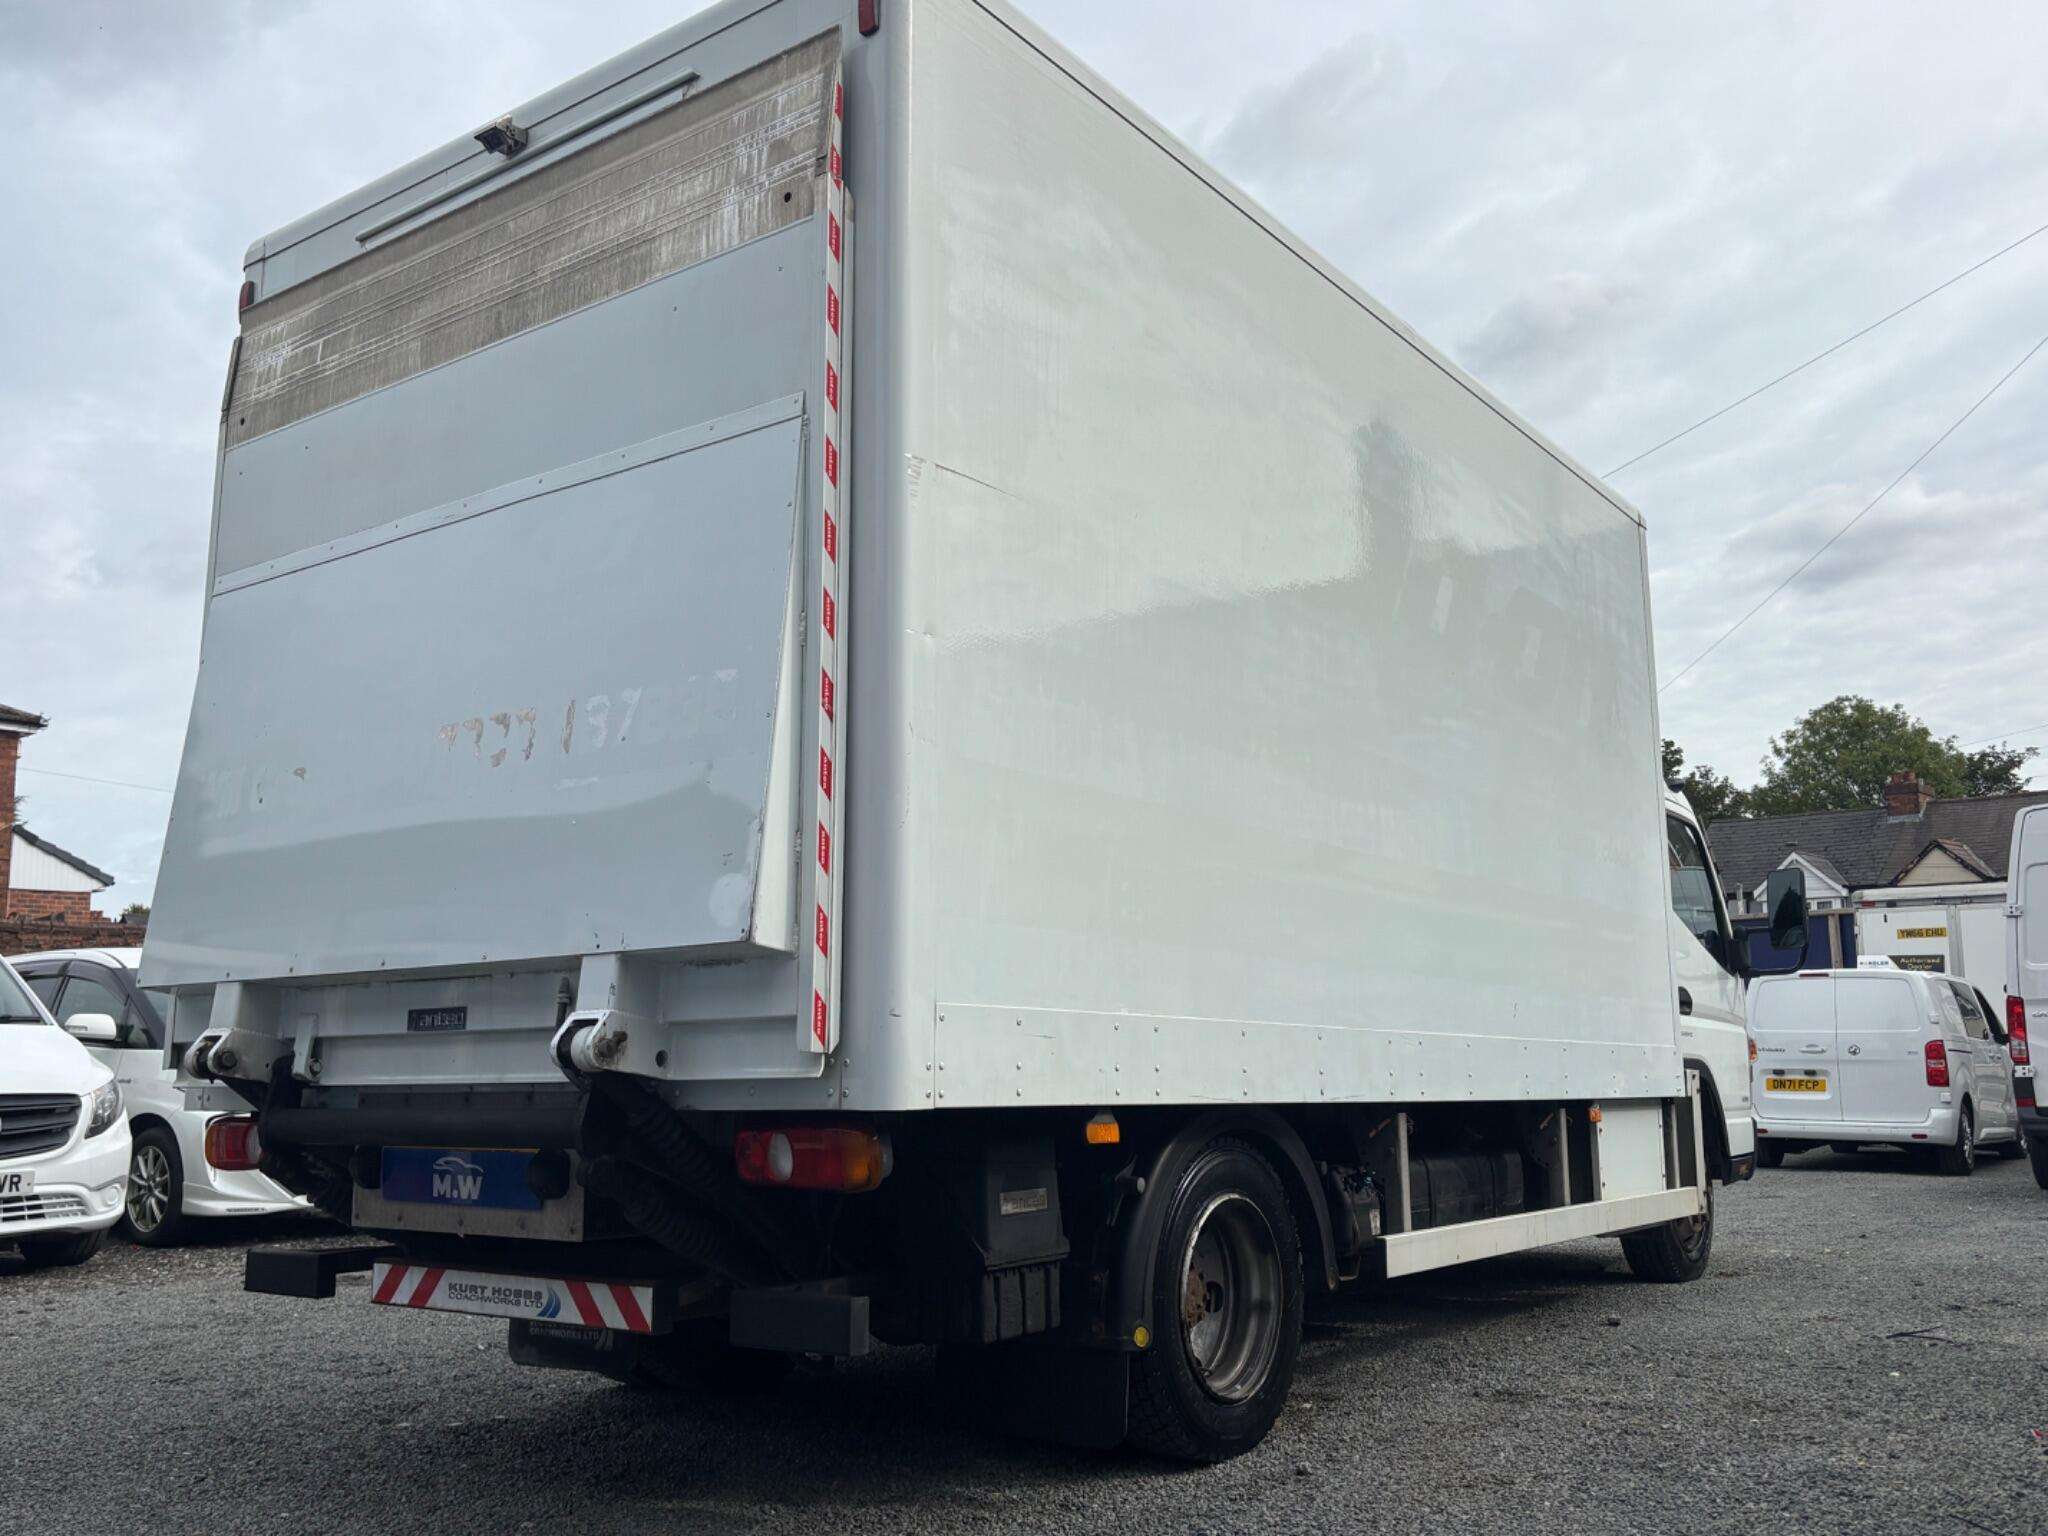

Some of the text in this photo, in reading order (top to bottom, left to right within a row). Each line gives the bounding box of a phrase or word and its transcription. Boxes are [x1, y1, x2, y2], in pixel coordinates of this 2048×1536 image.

[1773, 1079, 1819, 1090] DN71 FCP
[432, 1174, 482, 1200] M.W
[448, 1281, 543, 1301] KURT HOBBS
[448, 1292, 544, 1309] COACHWORKS LTD
